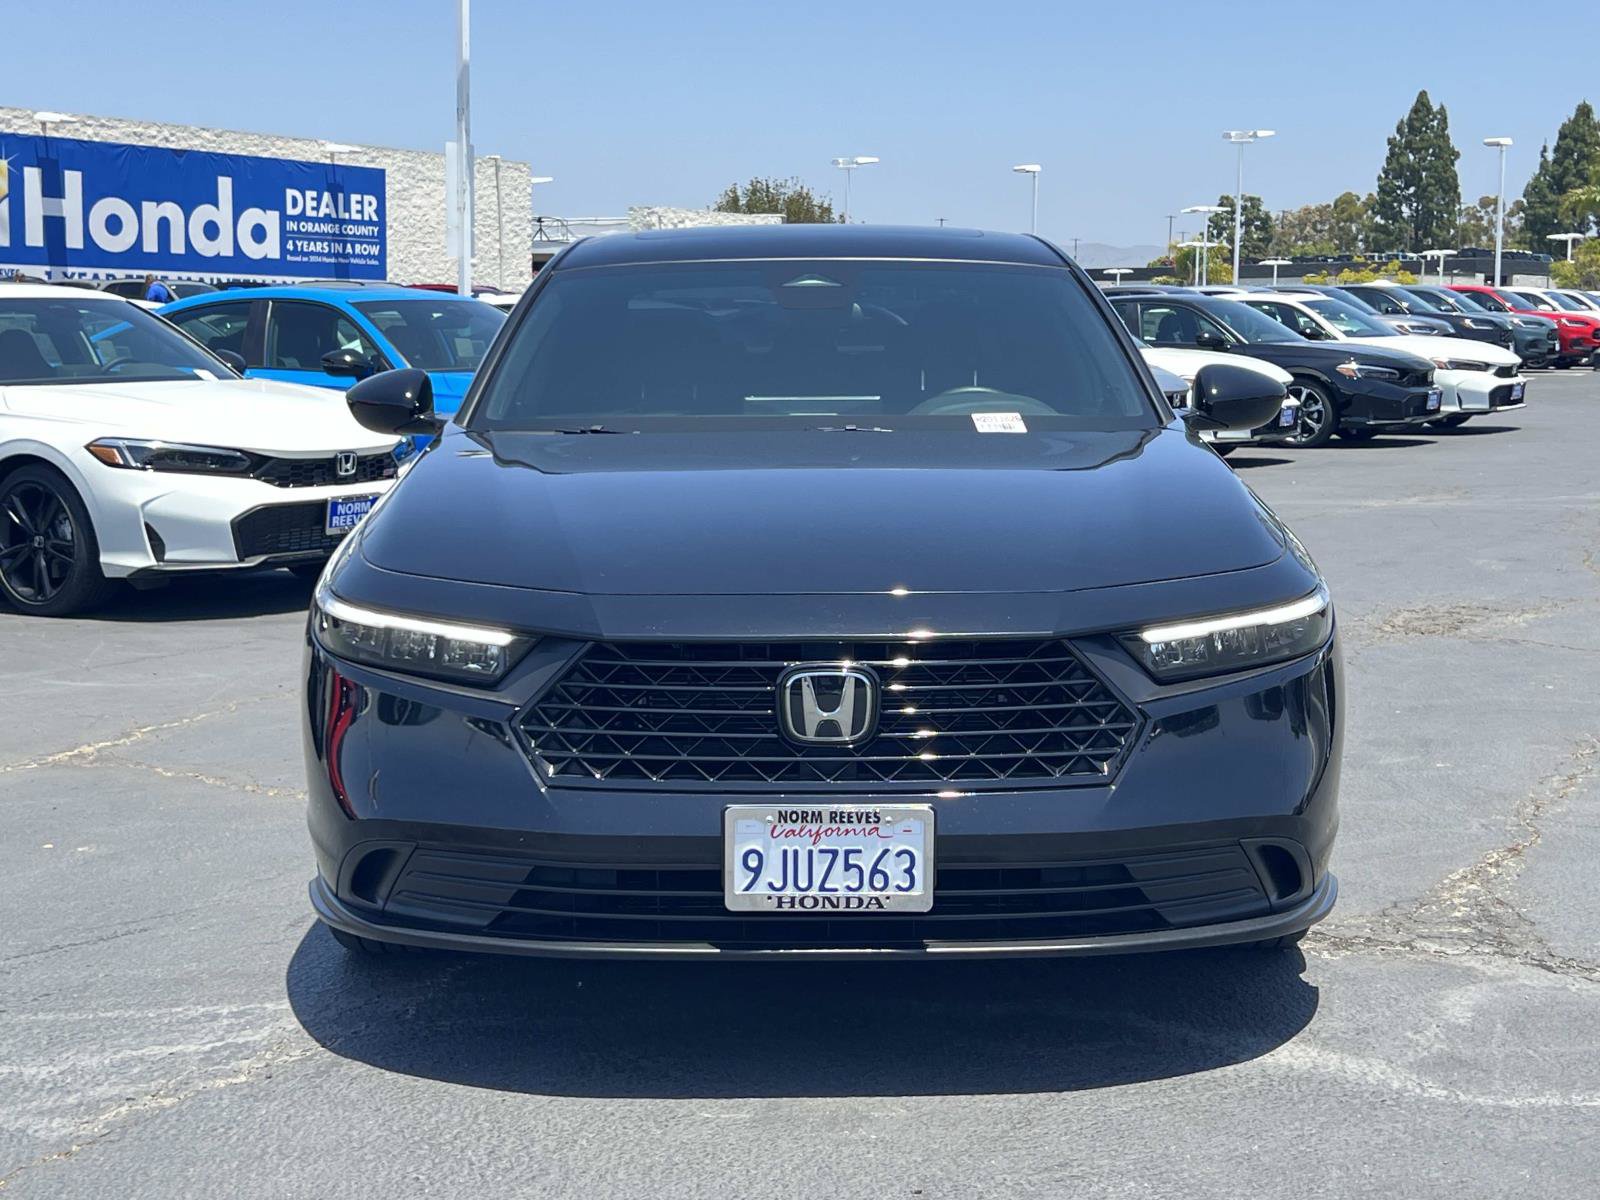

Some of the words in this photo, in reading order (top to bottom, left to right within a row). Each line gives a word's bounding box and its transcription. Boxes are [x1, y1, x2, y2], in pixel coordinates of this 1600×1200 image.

[285, 188, 379, 222] DEALER
[23, 166, 281, 260] Honda
[286, 221, 298, 232] IN
[299, 221, 340, 234] ORANGE
[341, 224, 379, 236] COUNTY
[286, 240, 294, 251] 4
[295, 240, 329, 254] YEARS
[331, 242, 343, 254] IN
[345, 243, 353, 255] A
[354, 244, 380, 256] ROW
[337, 501, 371, 515] NORM
[332, 514, 366, 527] REEV
[777, 809, 823, 824] NORM
[829, 809, 881, 824] REEVES
[770, 823, 894, 846] California
[741, 848, 917, 893] 9JUZ563
[774, 895, 887, 910] HONDA
